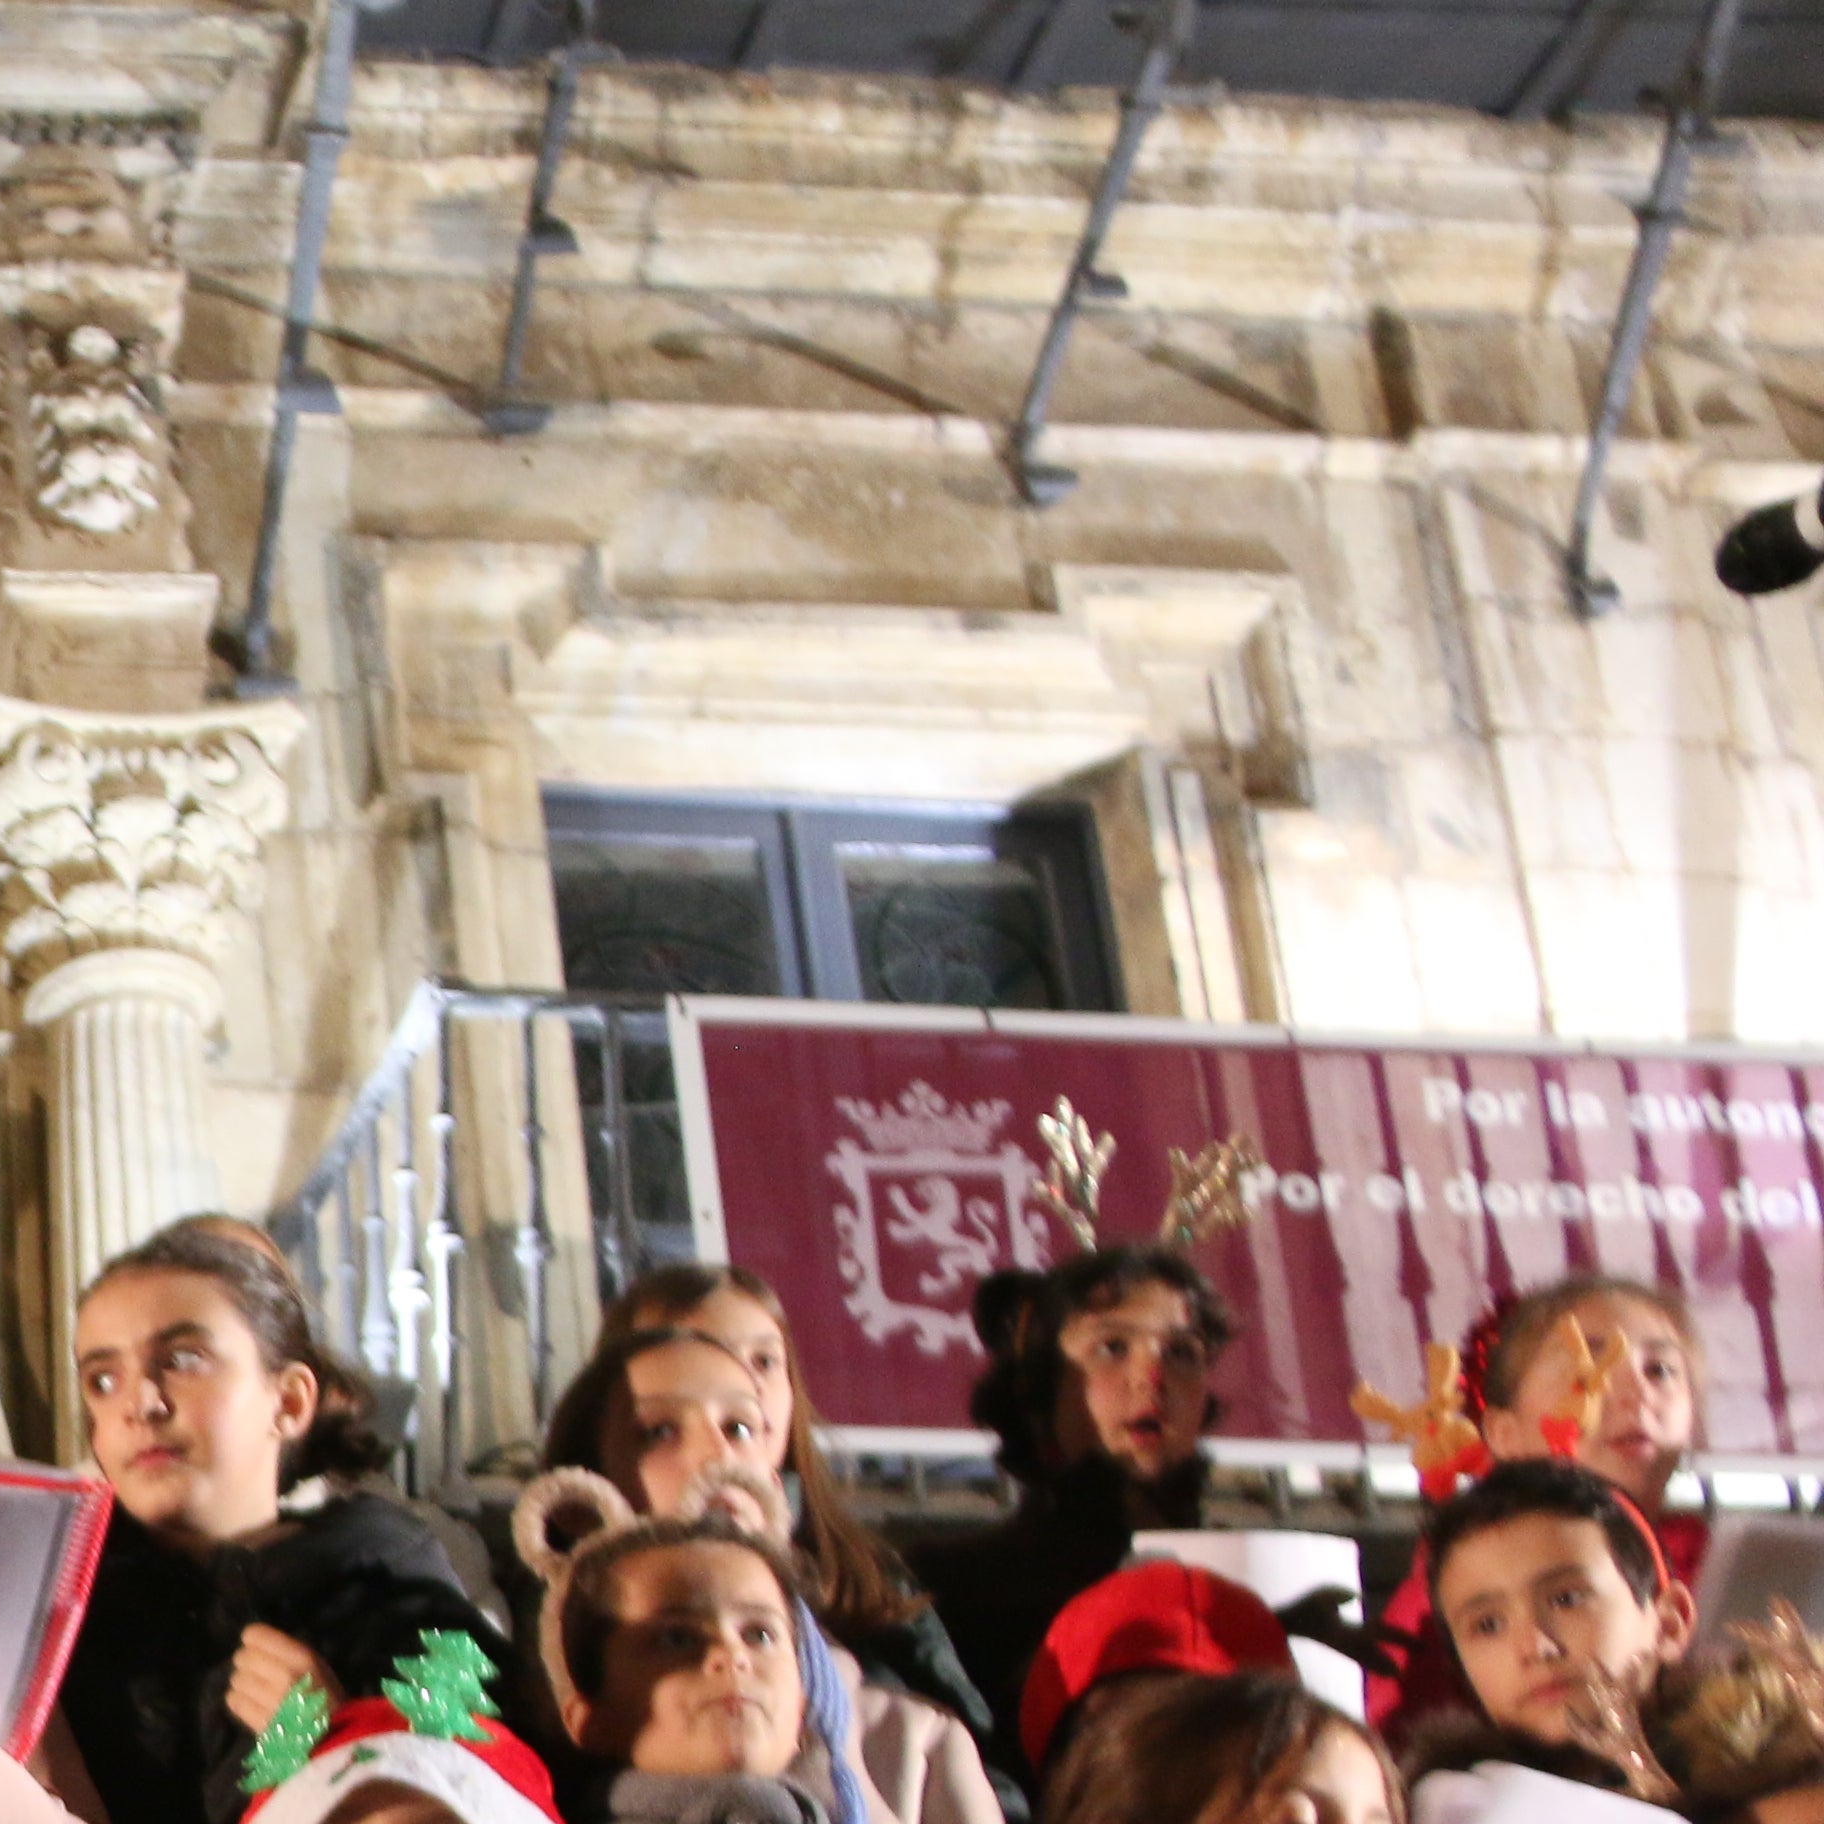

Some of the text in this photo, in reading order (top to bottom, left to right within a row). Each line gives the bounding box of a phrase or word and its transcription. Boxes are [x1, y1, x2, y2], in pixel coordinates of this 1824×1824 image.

[1422, 1076, 1528, 1128] Por
[1545, 1079, 1610, 1131] la
[1239, 1161, 1824, 1230] Por el derecho del
